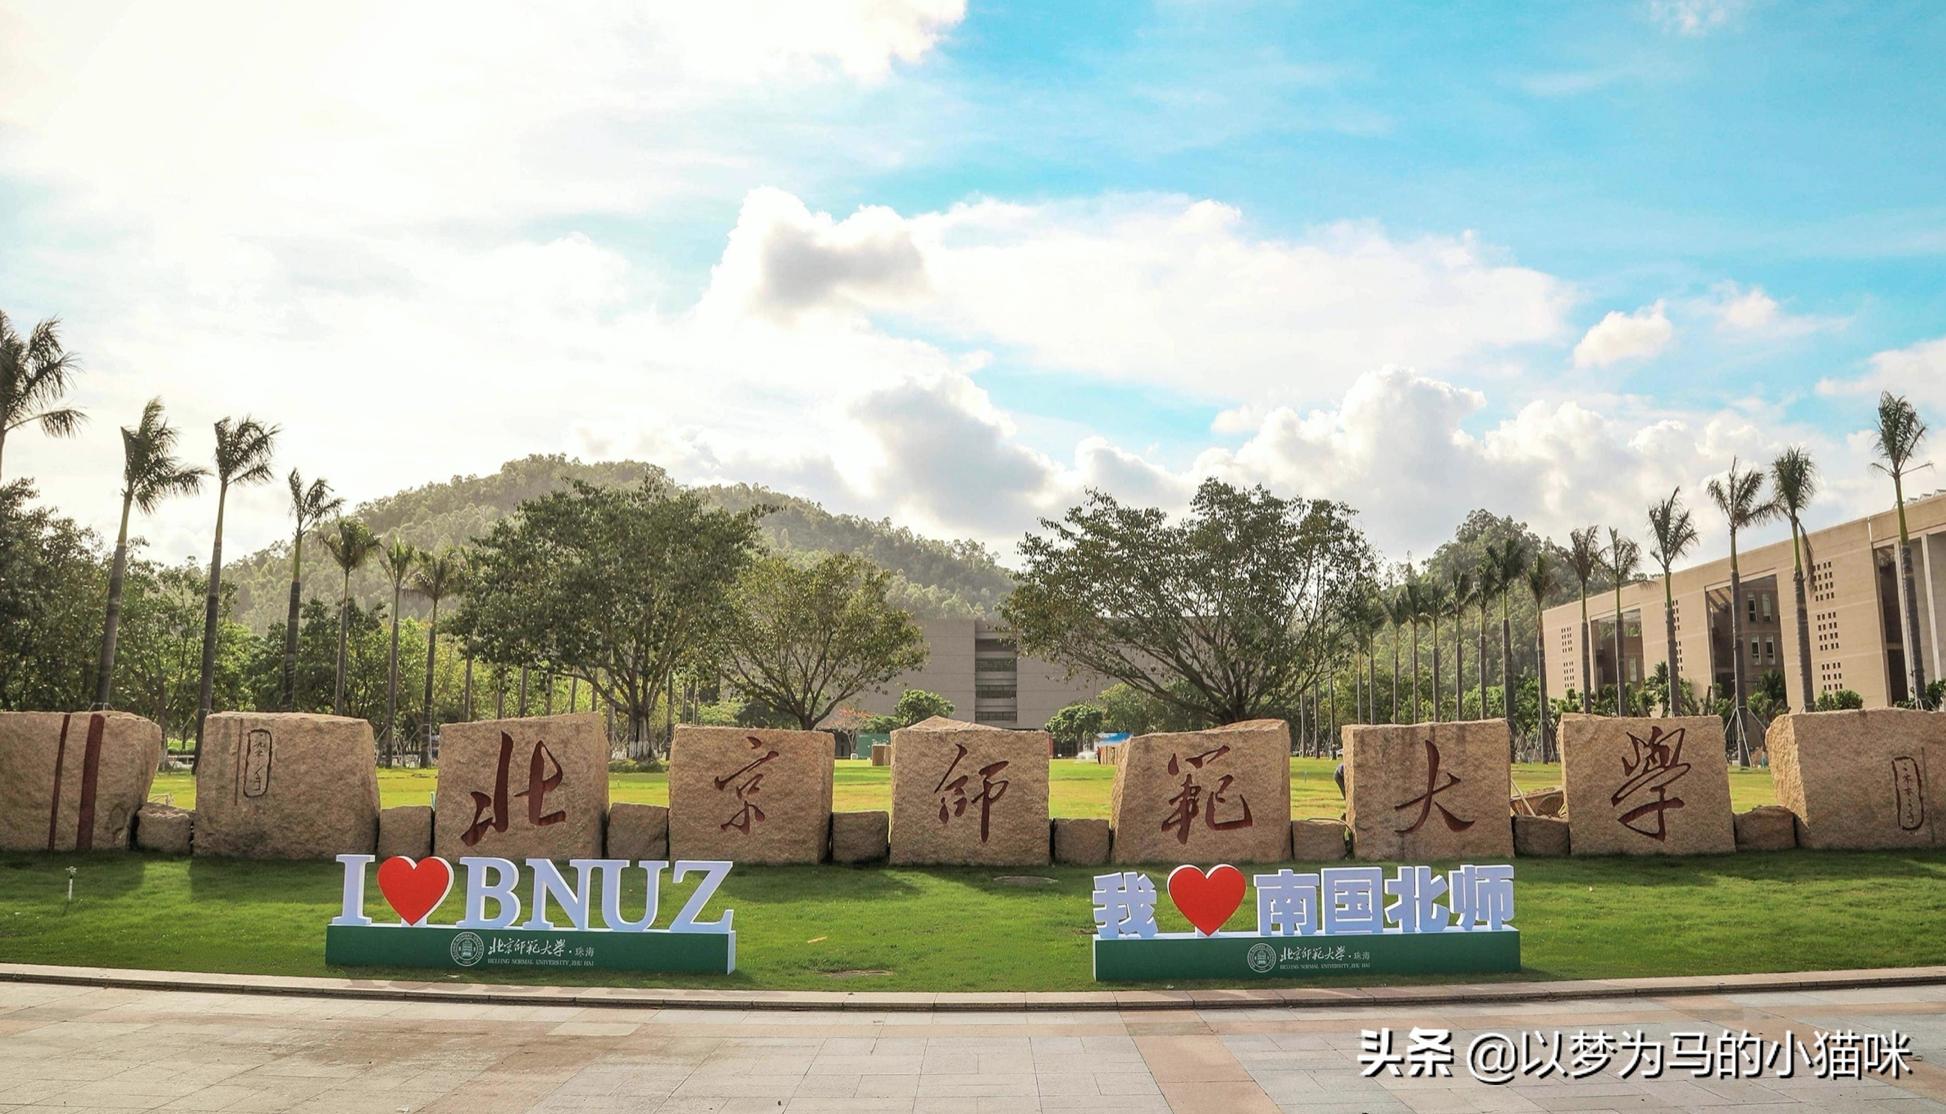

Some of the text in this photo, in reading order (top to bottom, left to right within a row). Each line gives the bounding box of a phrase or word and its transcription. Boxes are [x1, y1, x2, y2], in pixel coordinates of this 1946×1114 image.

[460, 729, 566, 847] 北
[714, 736, 779, 836] 京
[1394, 739, 1476, 834] 大
[332, 854, 734, 933] I BNUZ
[1092, 864, 1514, 939] 我 南国北师
